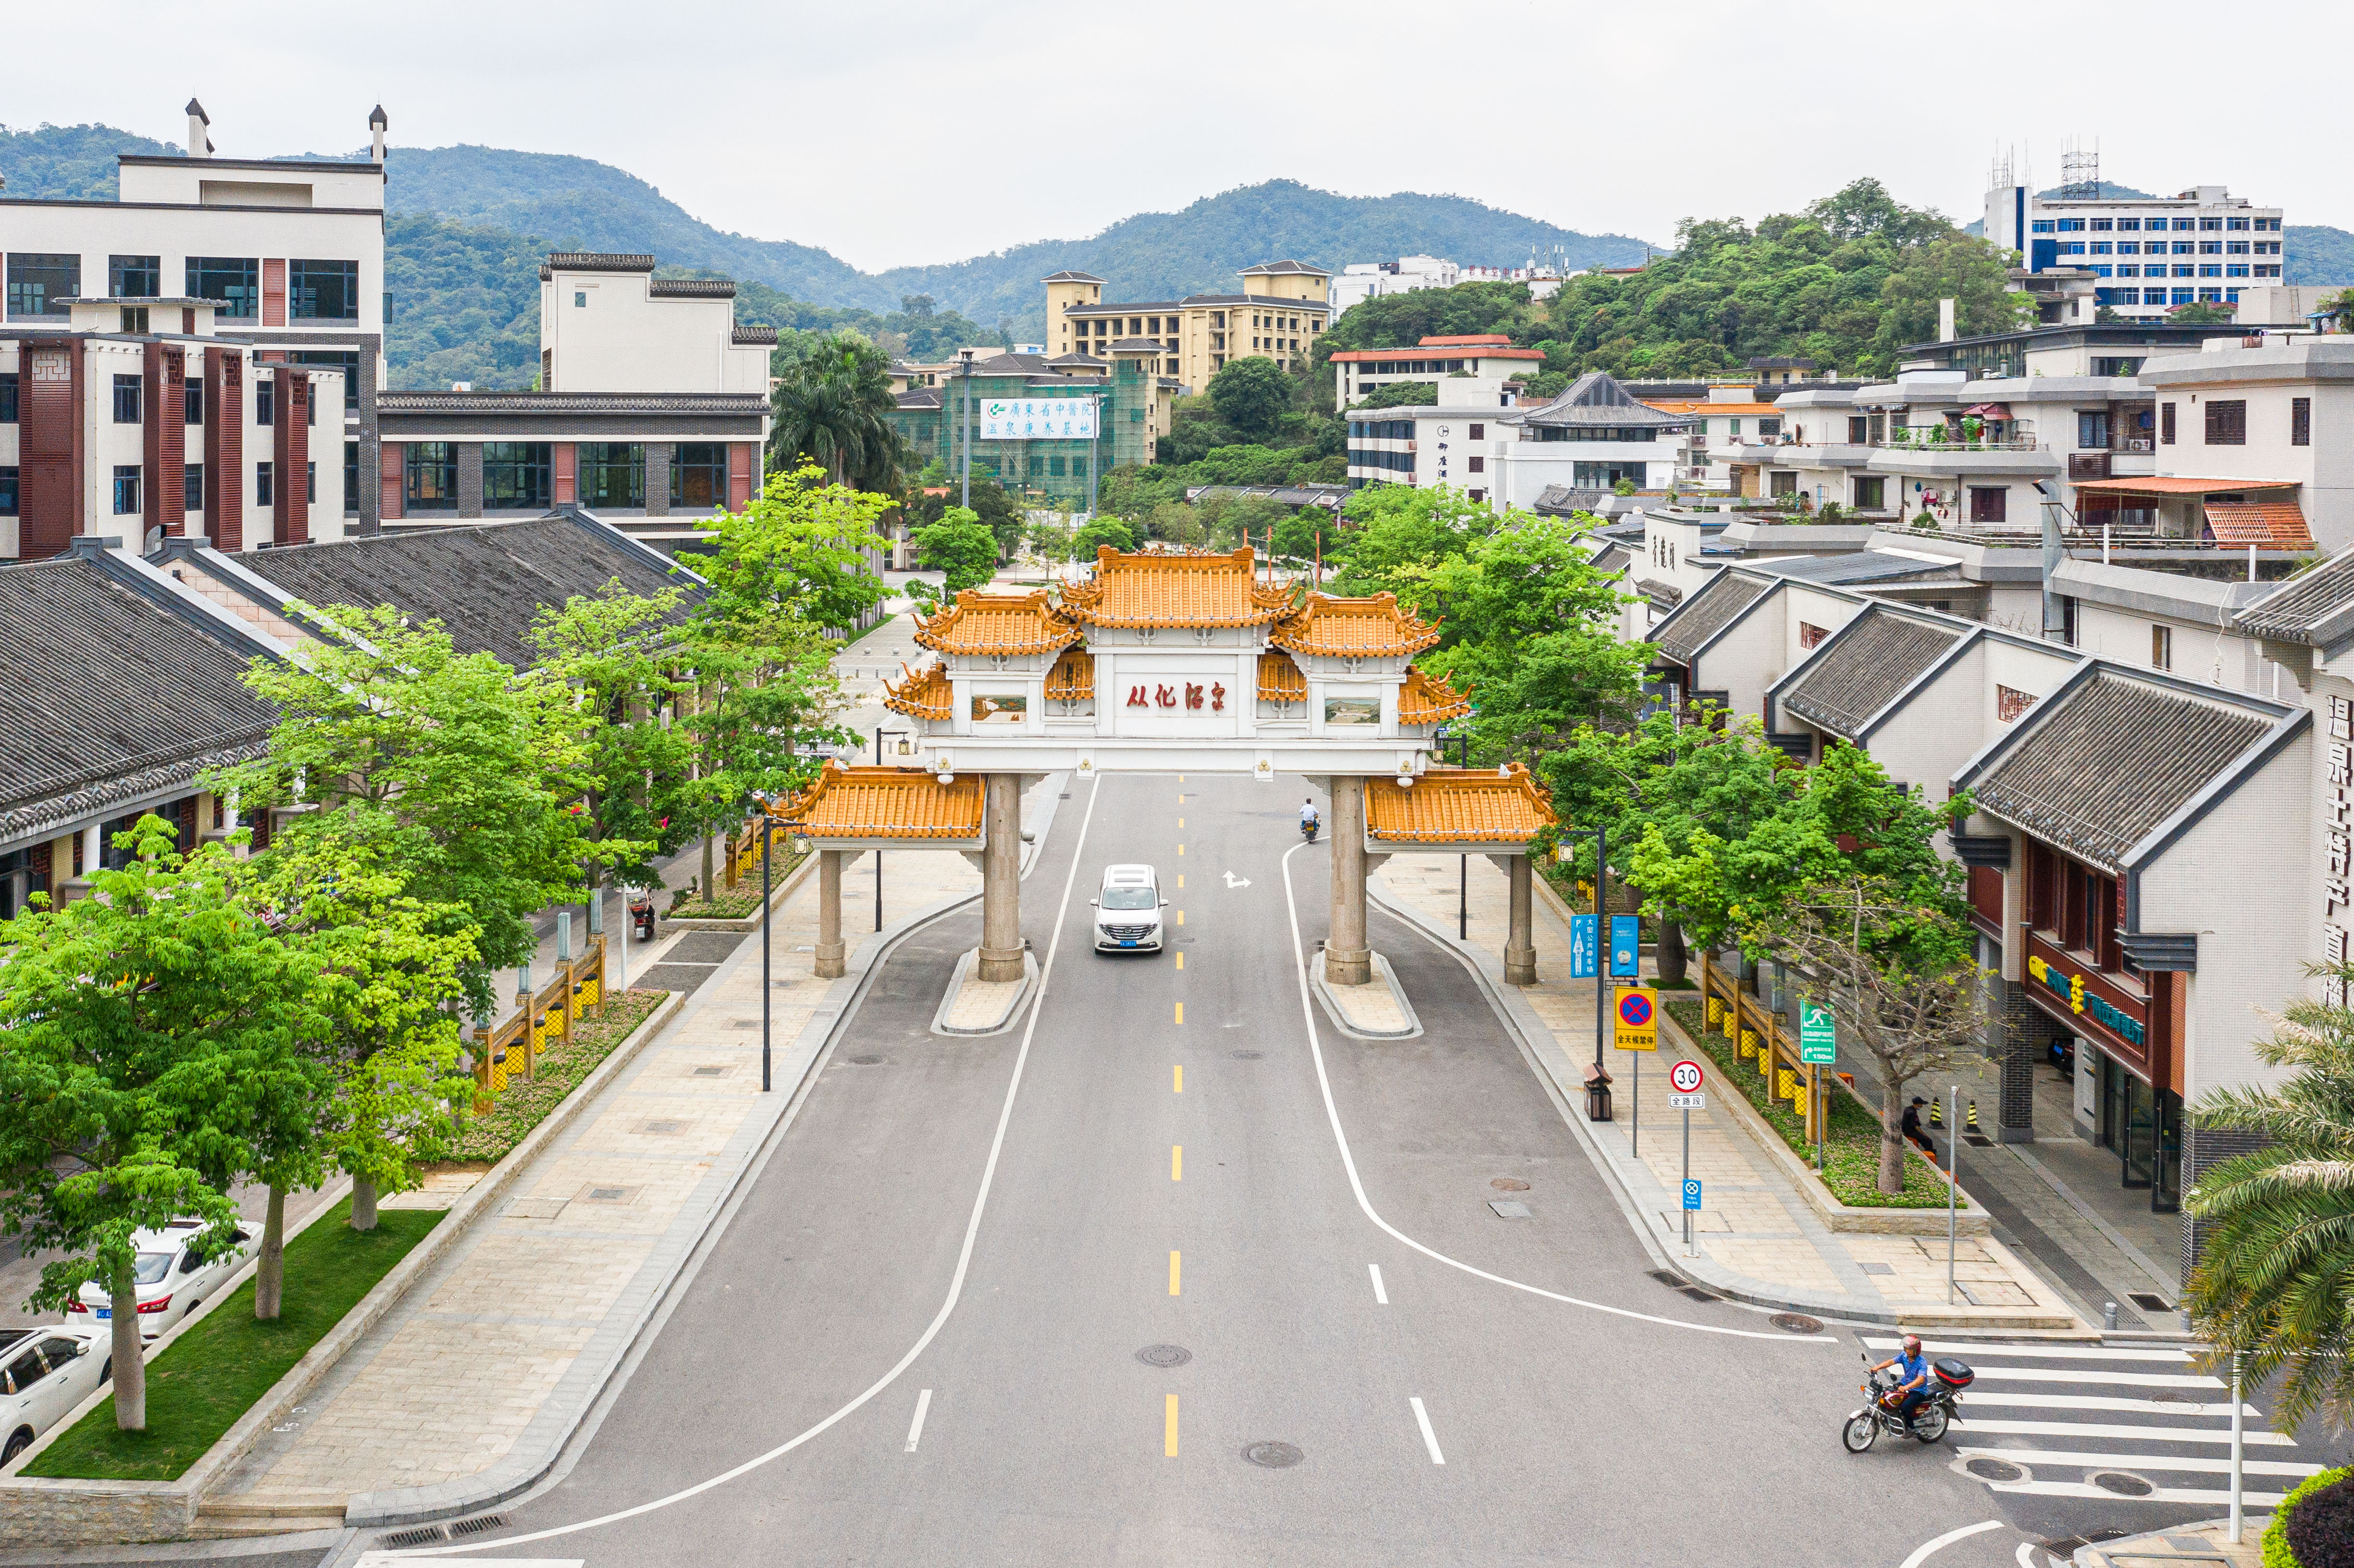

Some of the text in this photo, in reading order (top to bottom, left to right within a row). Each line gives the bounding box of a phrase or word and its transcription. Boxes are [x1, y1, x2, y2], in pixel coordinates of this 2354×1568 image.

[987, 421, 1092, 436] 温泉康养基地
[1618, 1035, 1654, 1045] 全天候禁停
[1678, 1069, 1696, 1084] 30
[1672, 1097, 1701, 1105] 全路段
